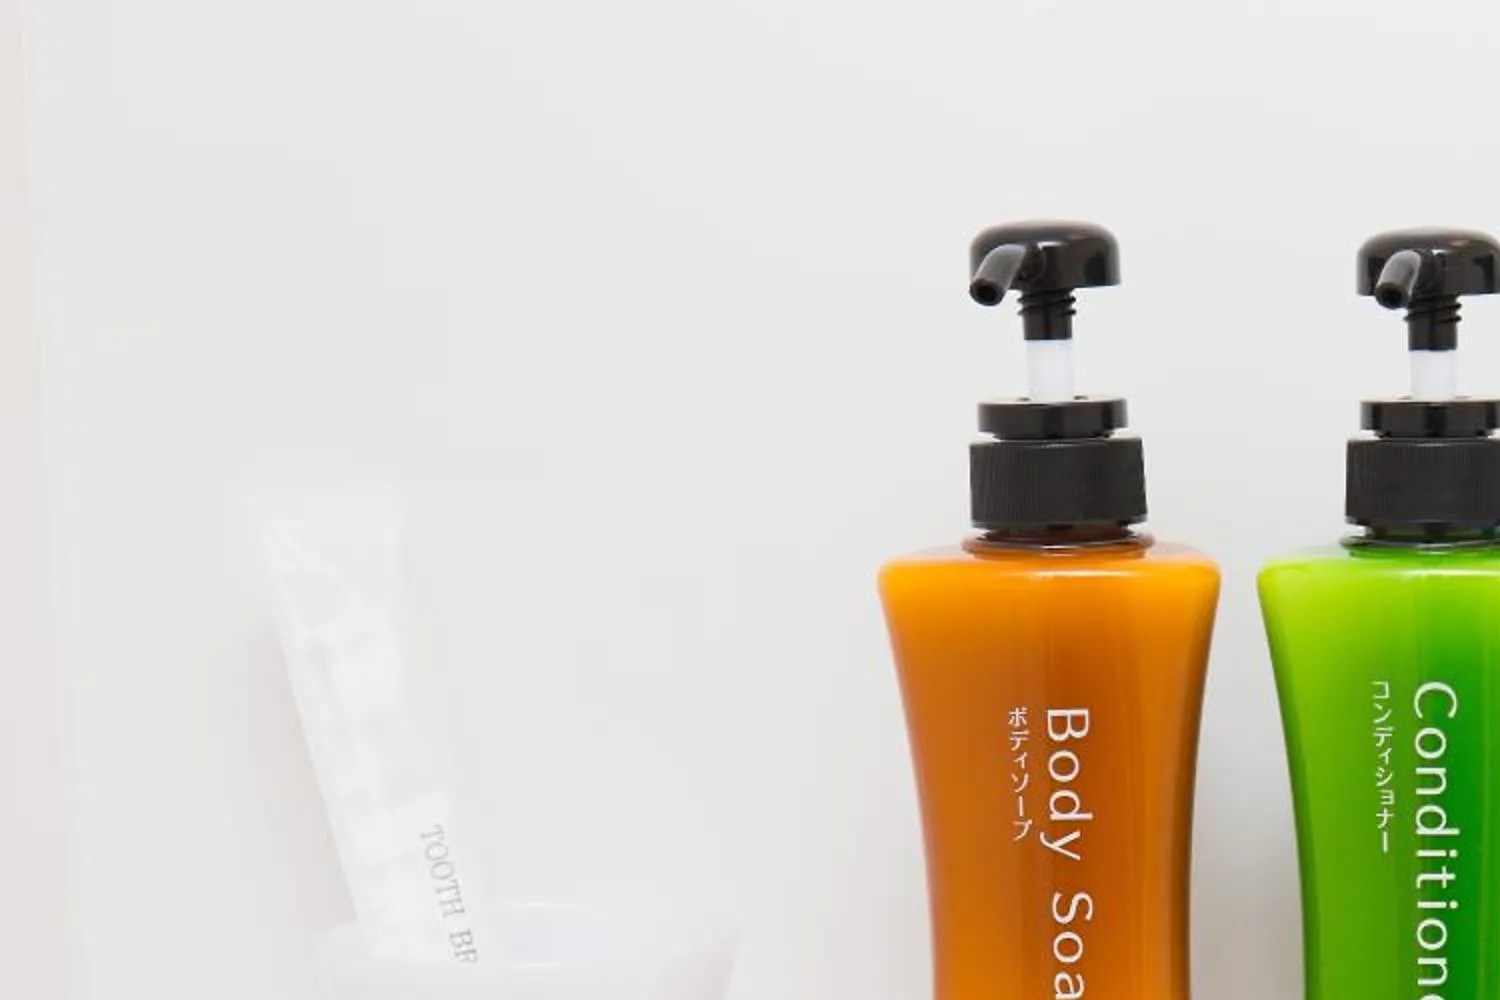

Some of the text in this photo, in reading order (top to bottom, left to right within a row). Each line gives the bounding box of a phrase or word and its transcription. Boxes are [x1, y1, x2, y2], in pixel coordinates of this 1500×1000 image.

[1008, 706, 1033, 841] ボディソープ
[1040, 707, 1093, 861] Body
[1372, 680, 1395, 854] コンディショナー
[419, 823, 465, 919] TOOTH
